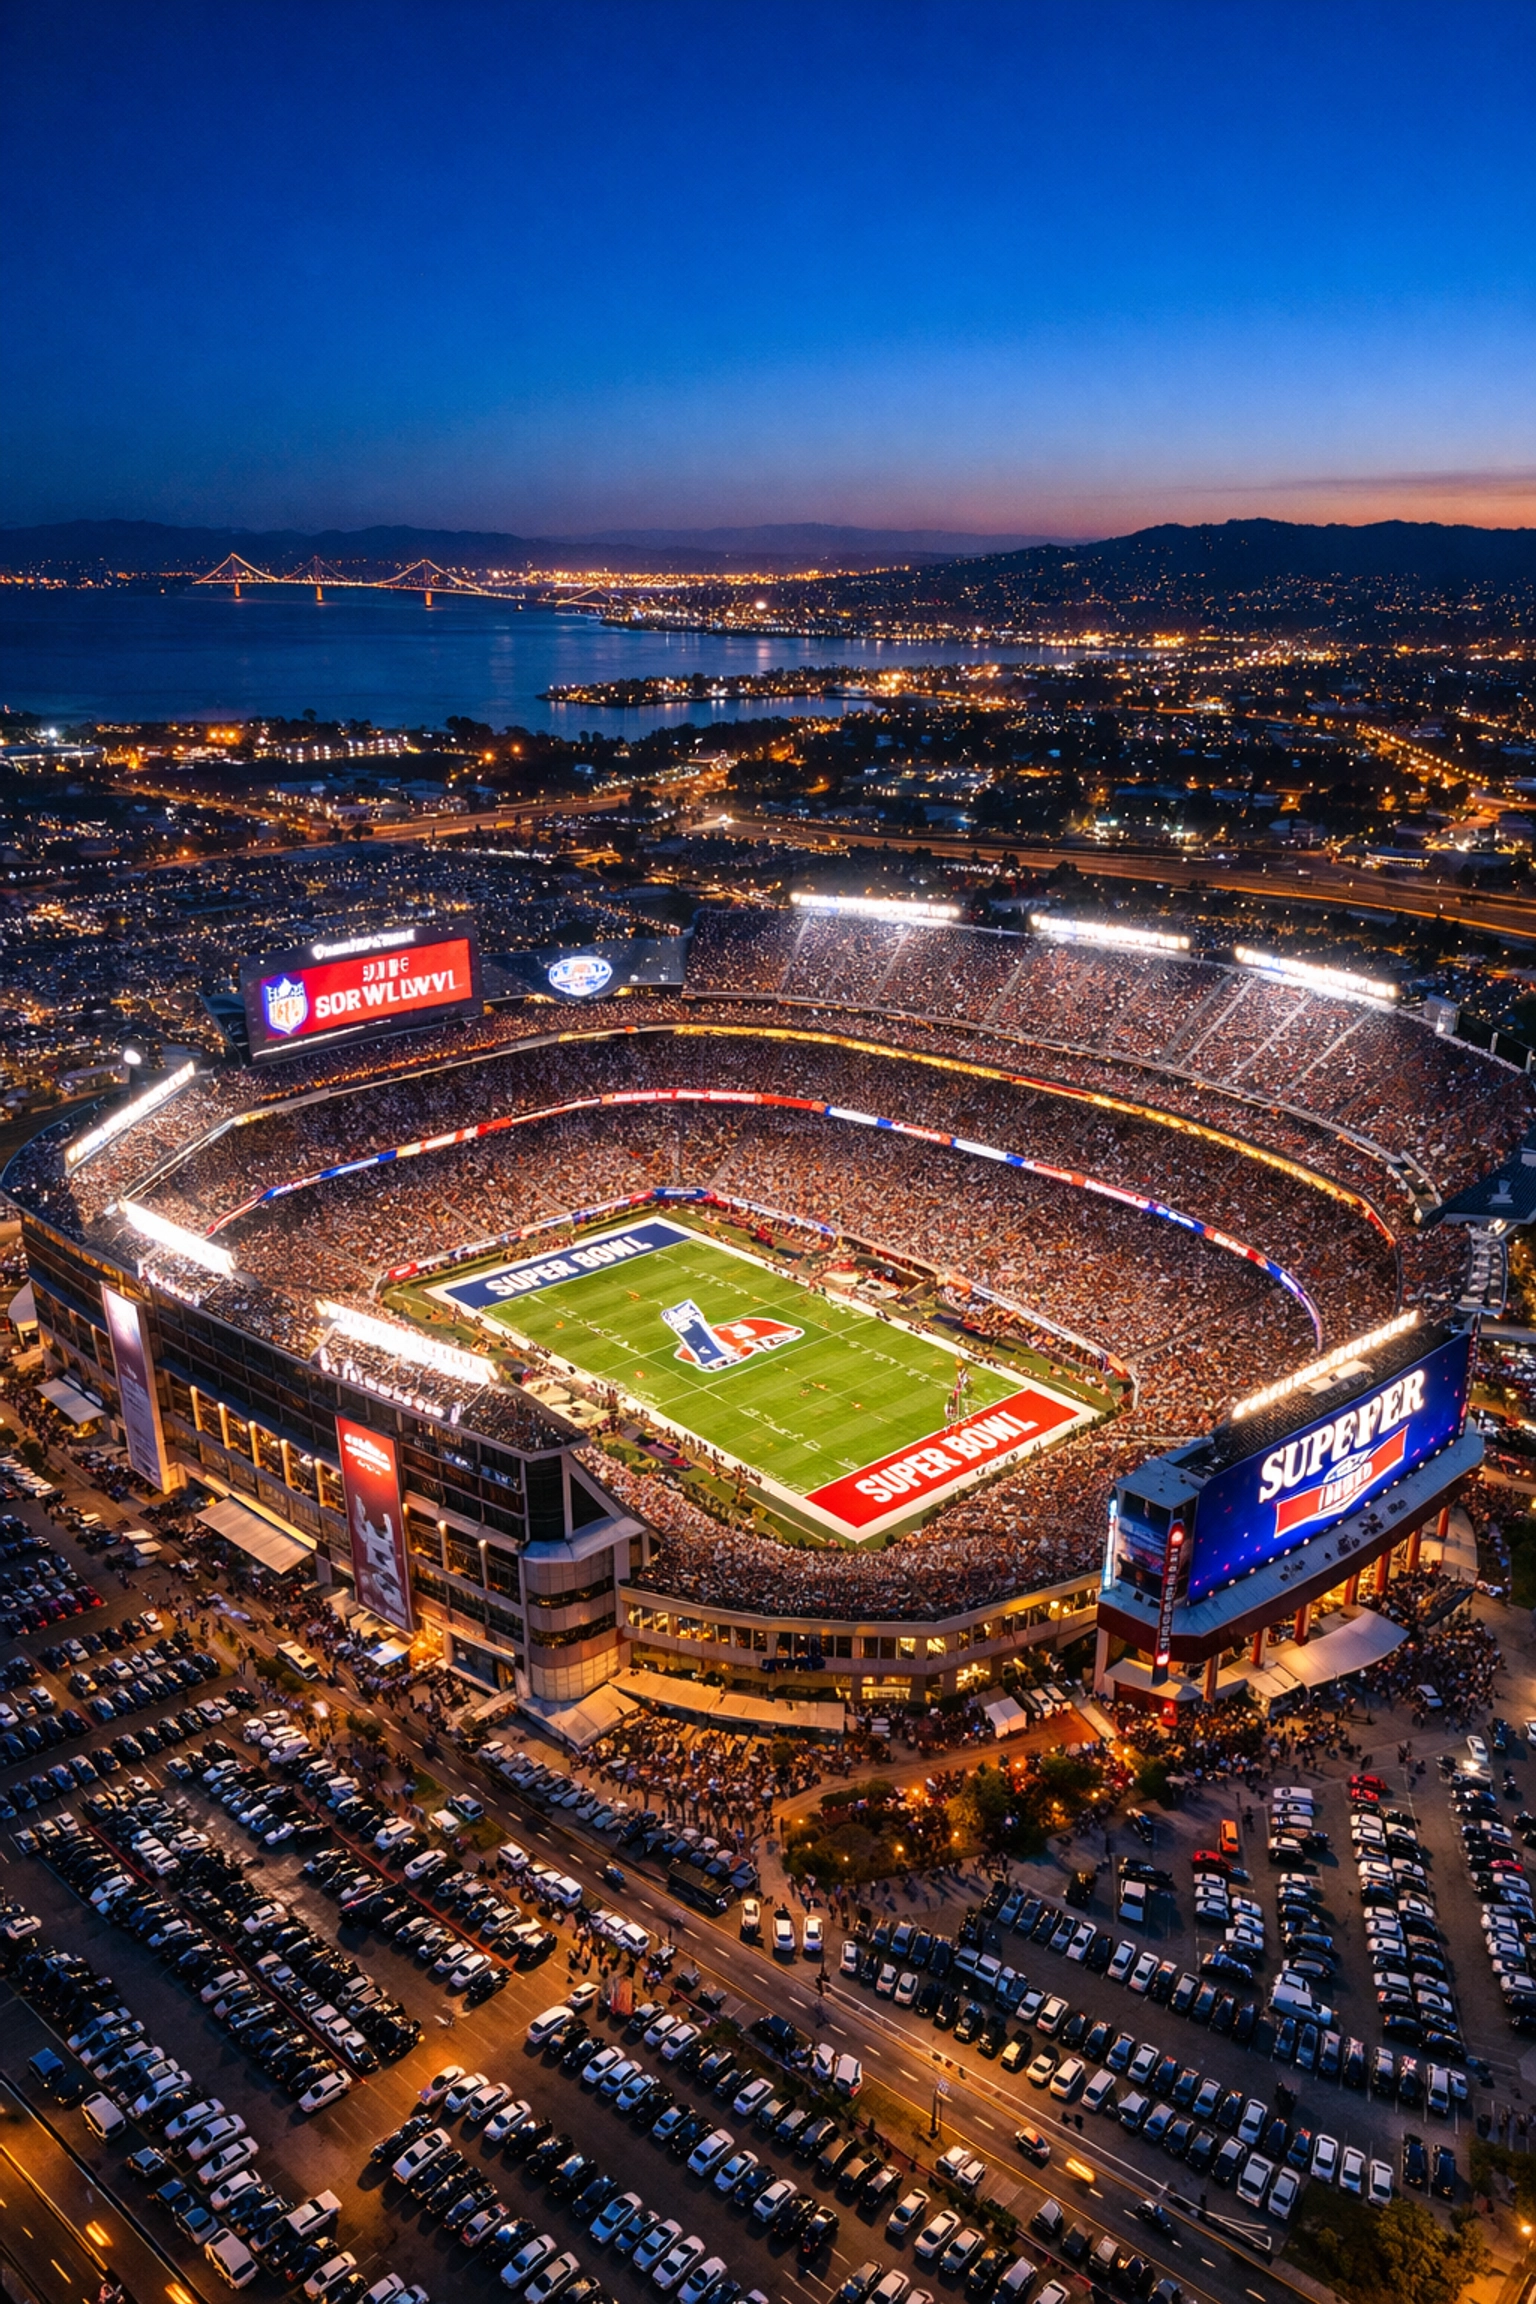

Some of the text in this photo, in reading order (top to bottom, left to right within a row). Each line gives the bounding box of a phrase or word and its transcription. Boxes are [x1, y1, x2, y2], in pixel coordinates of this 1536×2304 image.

[485, 1235, 653, 1296] SUPER BOWL
[854, 1410, 1039, 1503] SUPER BOWL
